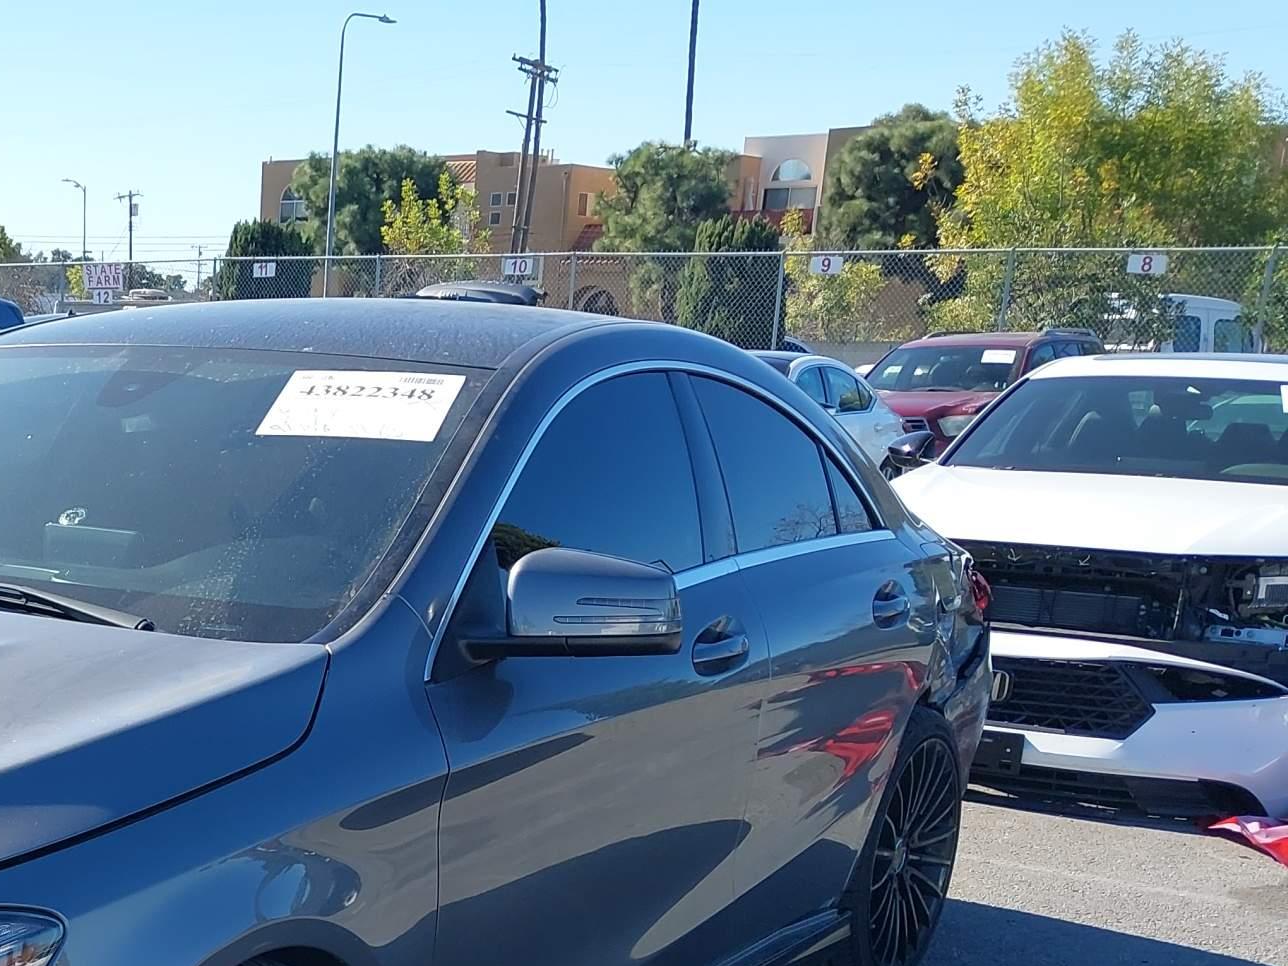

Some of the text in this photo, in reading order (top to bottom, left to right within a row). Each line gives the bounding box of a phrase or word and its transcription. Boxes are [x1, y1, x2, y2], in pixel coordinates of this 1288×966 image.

[85, 264, 121, 275] STATE
[258, 262, 268, 276] 11
[511, 259, 527, 273] 10
[821, 257, 831, 272] 9
[1141, 255, 1153, 272] 8
[88, 275, 120, 287] FARM
[97, 291, 109, 303] 12
[300, 384, 436, 400] 43822348
